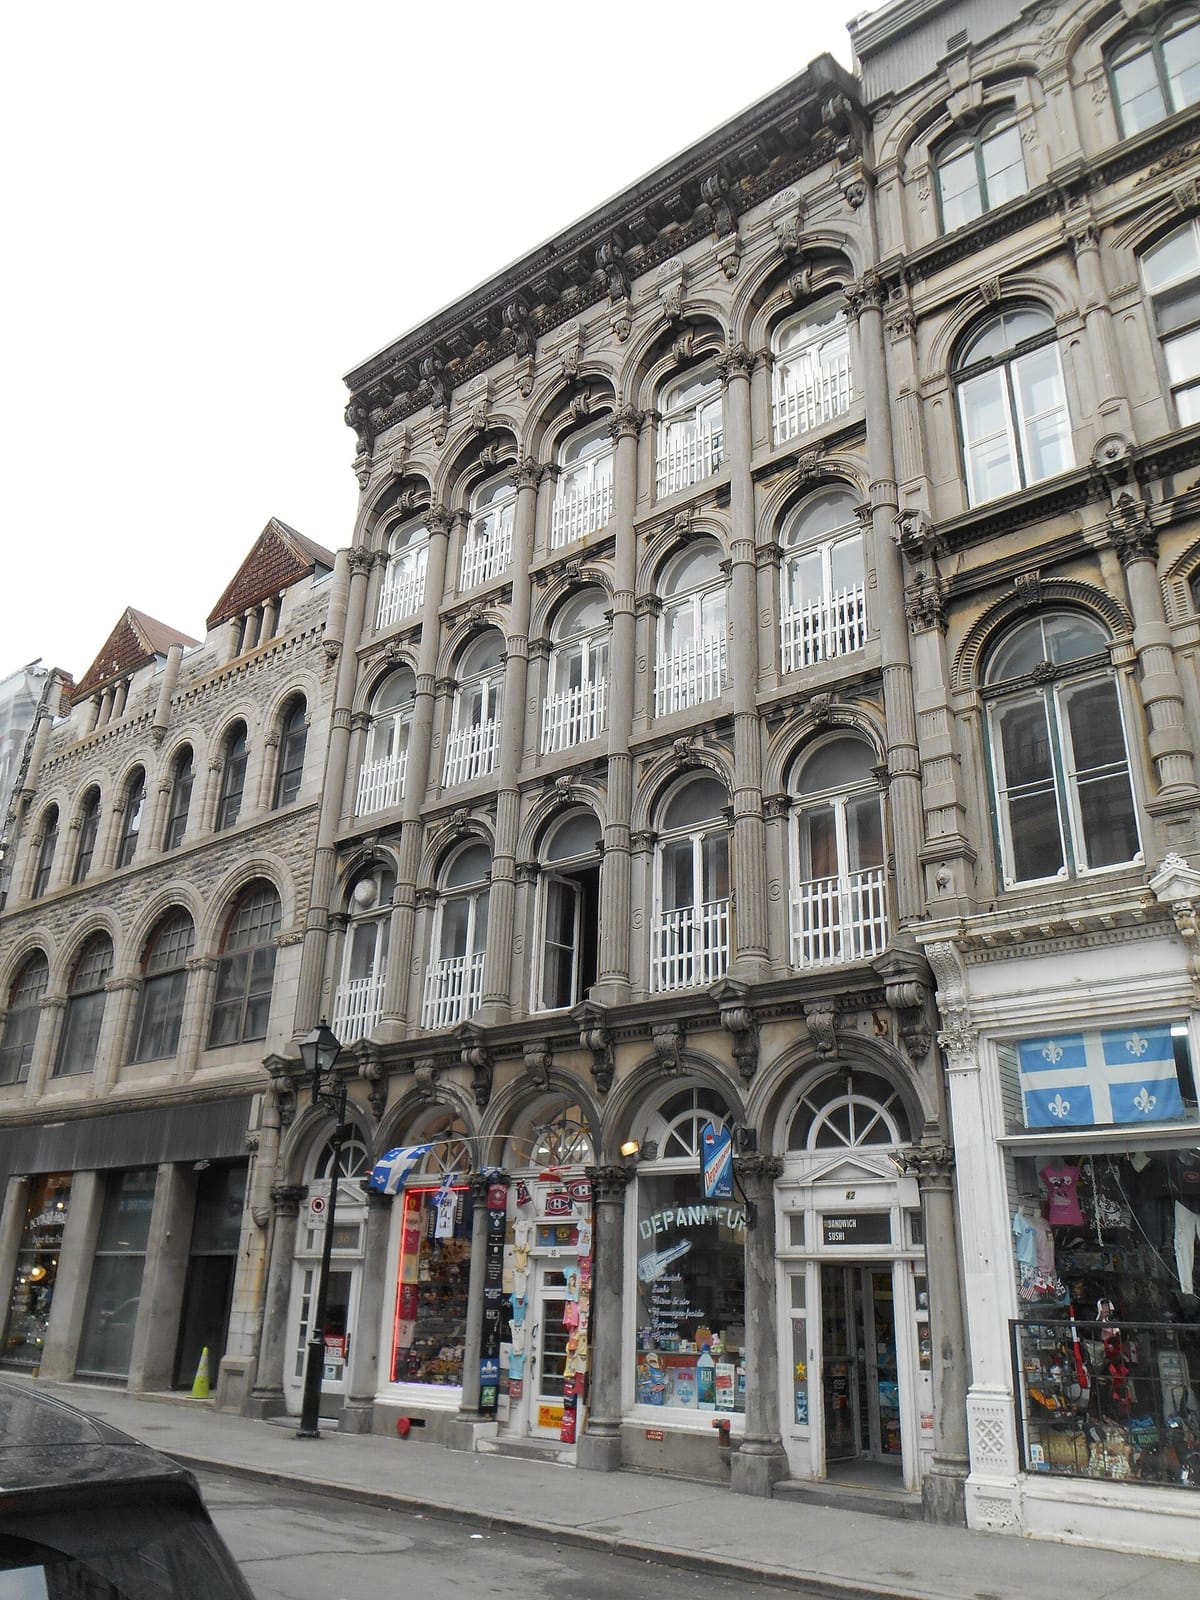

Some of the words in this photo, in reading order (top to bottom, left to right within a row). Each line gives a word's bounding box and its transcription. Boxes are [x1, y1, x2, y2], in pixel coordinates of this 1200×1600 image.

[845, 1191, 856, 1200] 42
[828, 1219, 857, 1229] SANDWICH
[828, 1231, 845, 1241] SUSHI
[678, 1372, 694, 1381] ATM
